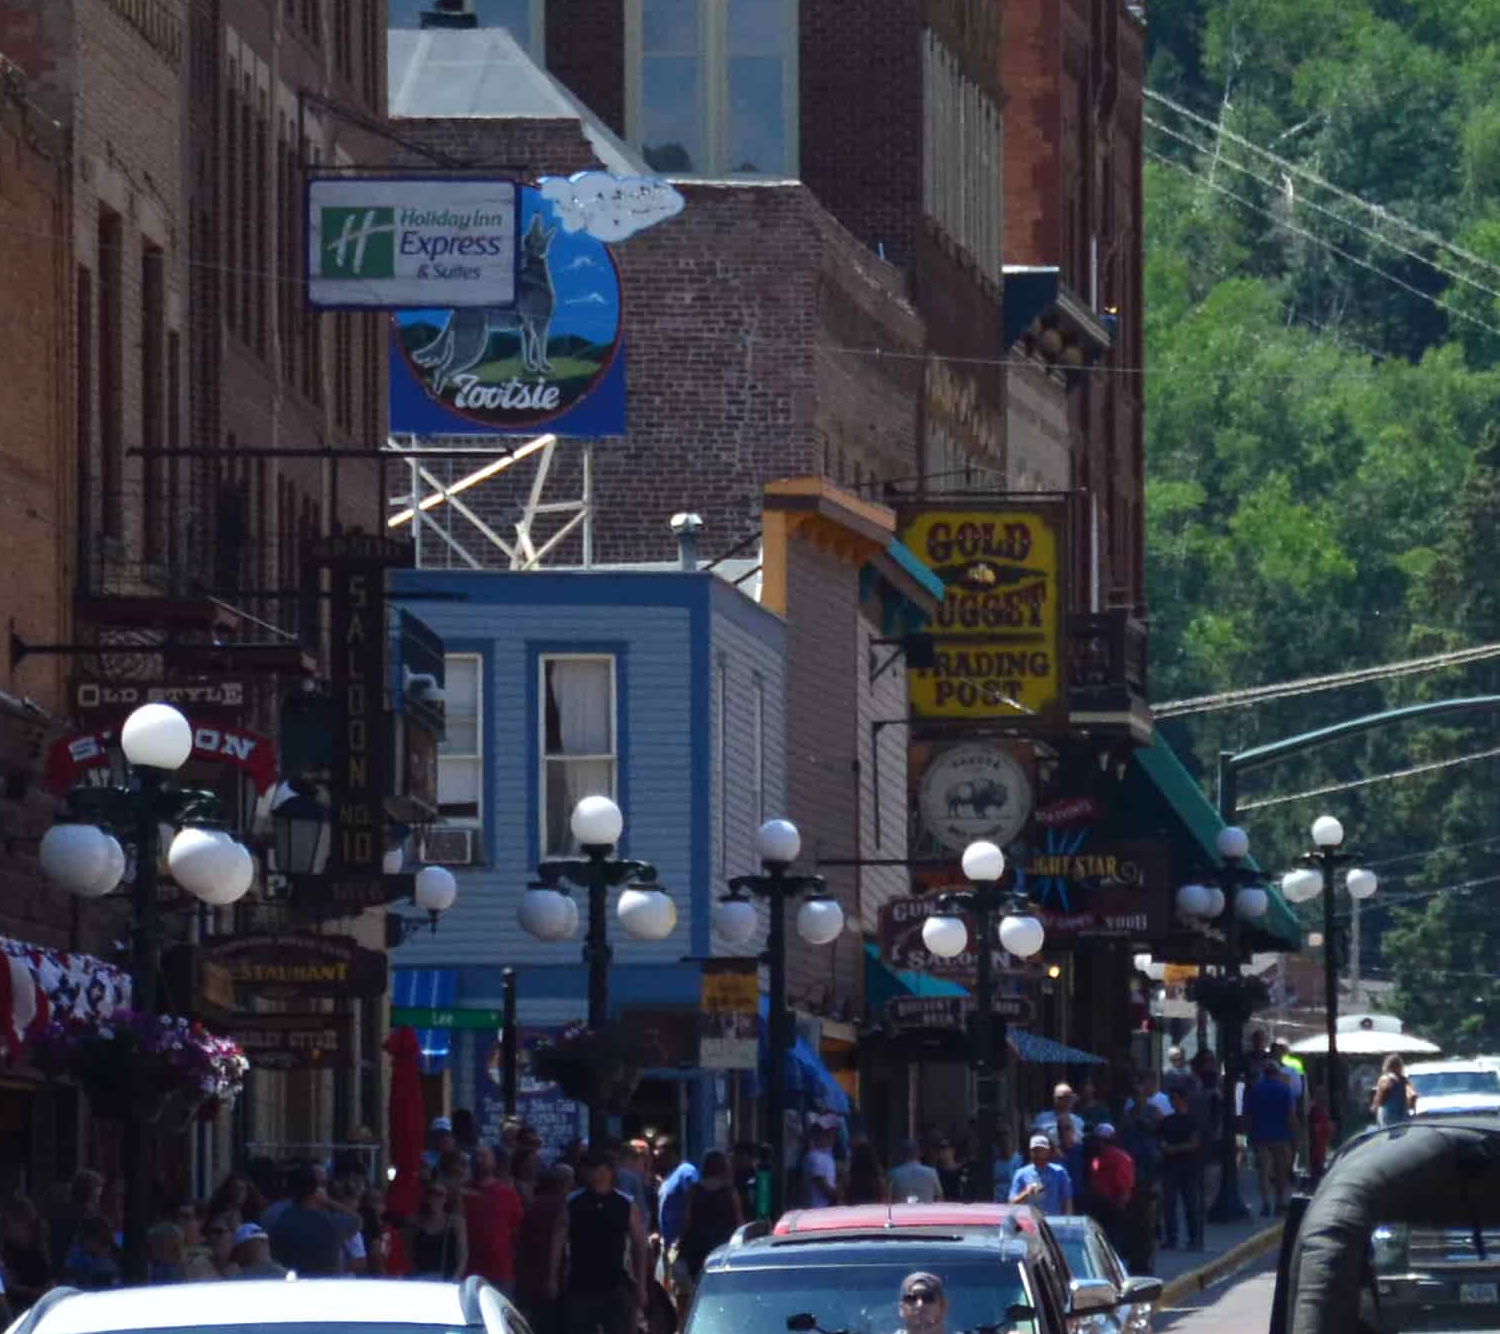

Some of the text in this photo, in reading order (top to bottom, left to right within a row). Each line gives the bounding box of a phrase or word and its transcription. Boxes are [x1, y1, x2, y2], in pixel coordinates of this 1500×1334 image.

[400, 208, 502, 228] Holiday Inn
[400, 231, 501, 261] Express
[452, 374, 561, 410] Tootsie
[927, 522, 1032, 561] GOLD
[932, 583, 1048, 627] UGGET
[935, 680, 1022, 708] POST
